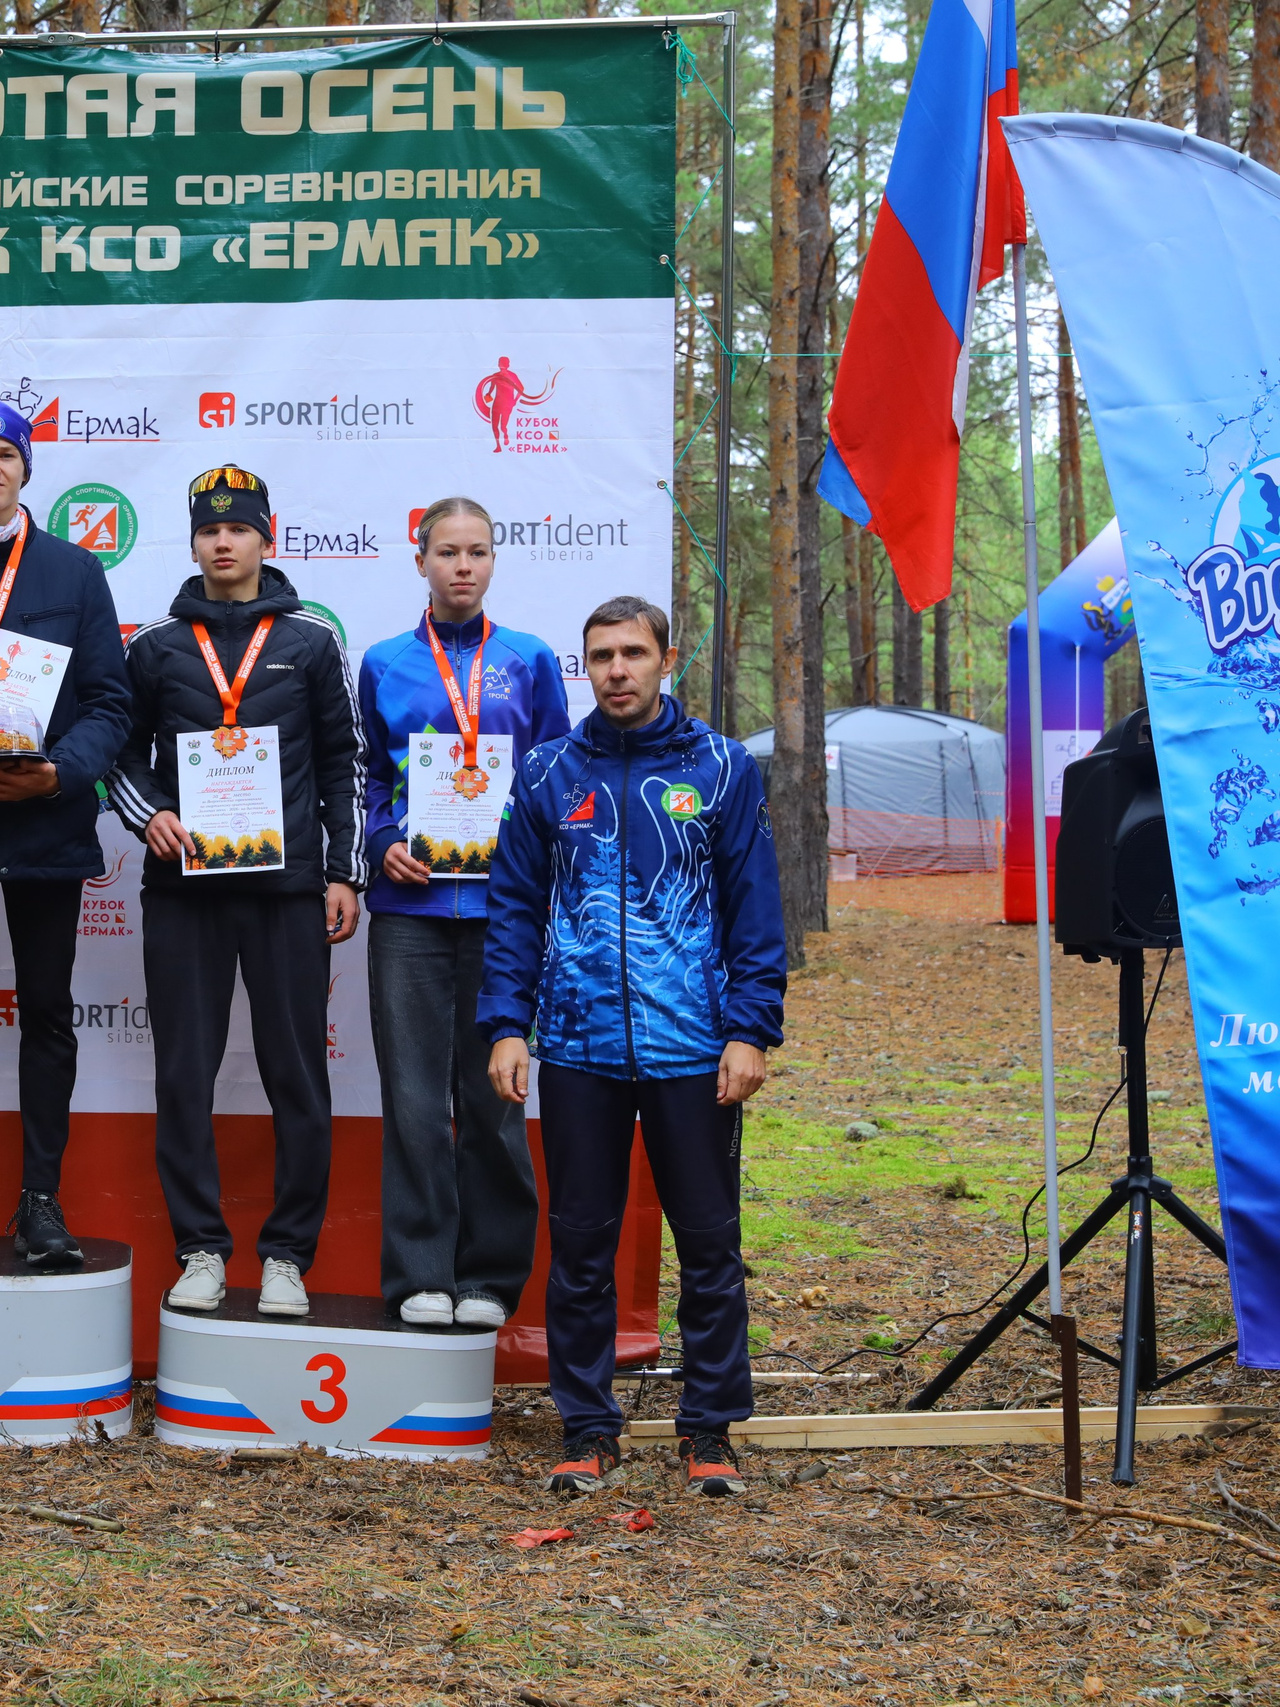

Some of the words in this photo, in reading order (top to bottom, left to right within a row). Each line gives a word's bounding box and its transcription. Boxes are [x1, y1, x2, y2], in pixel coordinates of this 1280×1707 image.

[240, 66, 567, 137] ОСЕНЬ
[175, 167, 542, 206] СОРЕВНОВАНИЯ
[40, 225, 181, 273] КСО
[211, 217, 541, 270] «ЕРМАК»
[244, 394, 414, 426] SPORTident
[67, 407, 160, 443] Ермак
[516, 418, 559, 427] КУБОК
[317, 427, 379, 441] siberia
[516, 431, 543, 440] КСО
[508, 444, 568, 453] «ЕРМАК»
[52, 495, 73, 529] ФЕДЕРАЦИЯ
[75, 487, 121, 501] СПОРТИВНОГО
[116, 504, 134, 559] ОРИЕНТИРОВАНИЯ
[493, 514, 628, 546] ORTident
[285, 524, 379, 560] Ермак
[530, 547, 593, 561] siberia
[4, 568, 16, 590] ОСЕНЬ
[241, 649, 258, 679] ЗОЛОТАЯ
[255, 628, 268, 647] ОСЕНЬ
[7, 668, 37, 683] ПЛОМ
[450, 676, 460, 698] ОСЕНЬ
[457, 700, 471, 732] ЗОЛОТАЯ
[233, 730, 242, 739] 3
[206, 766, 255, 778] ДИПЛОМ
[473, 772, 482, 781] 3
[83, 900, 125, 910] КУБОК
[83, 913, 110, 923] КСО
[76, 926, 133, 937] «ЕРМАК»
[107, 1030, 153, 1043] siber
[300, 1353, 348, 1424] 3
